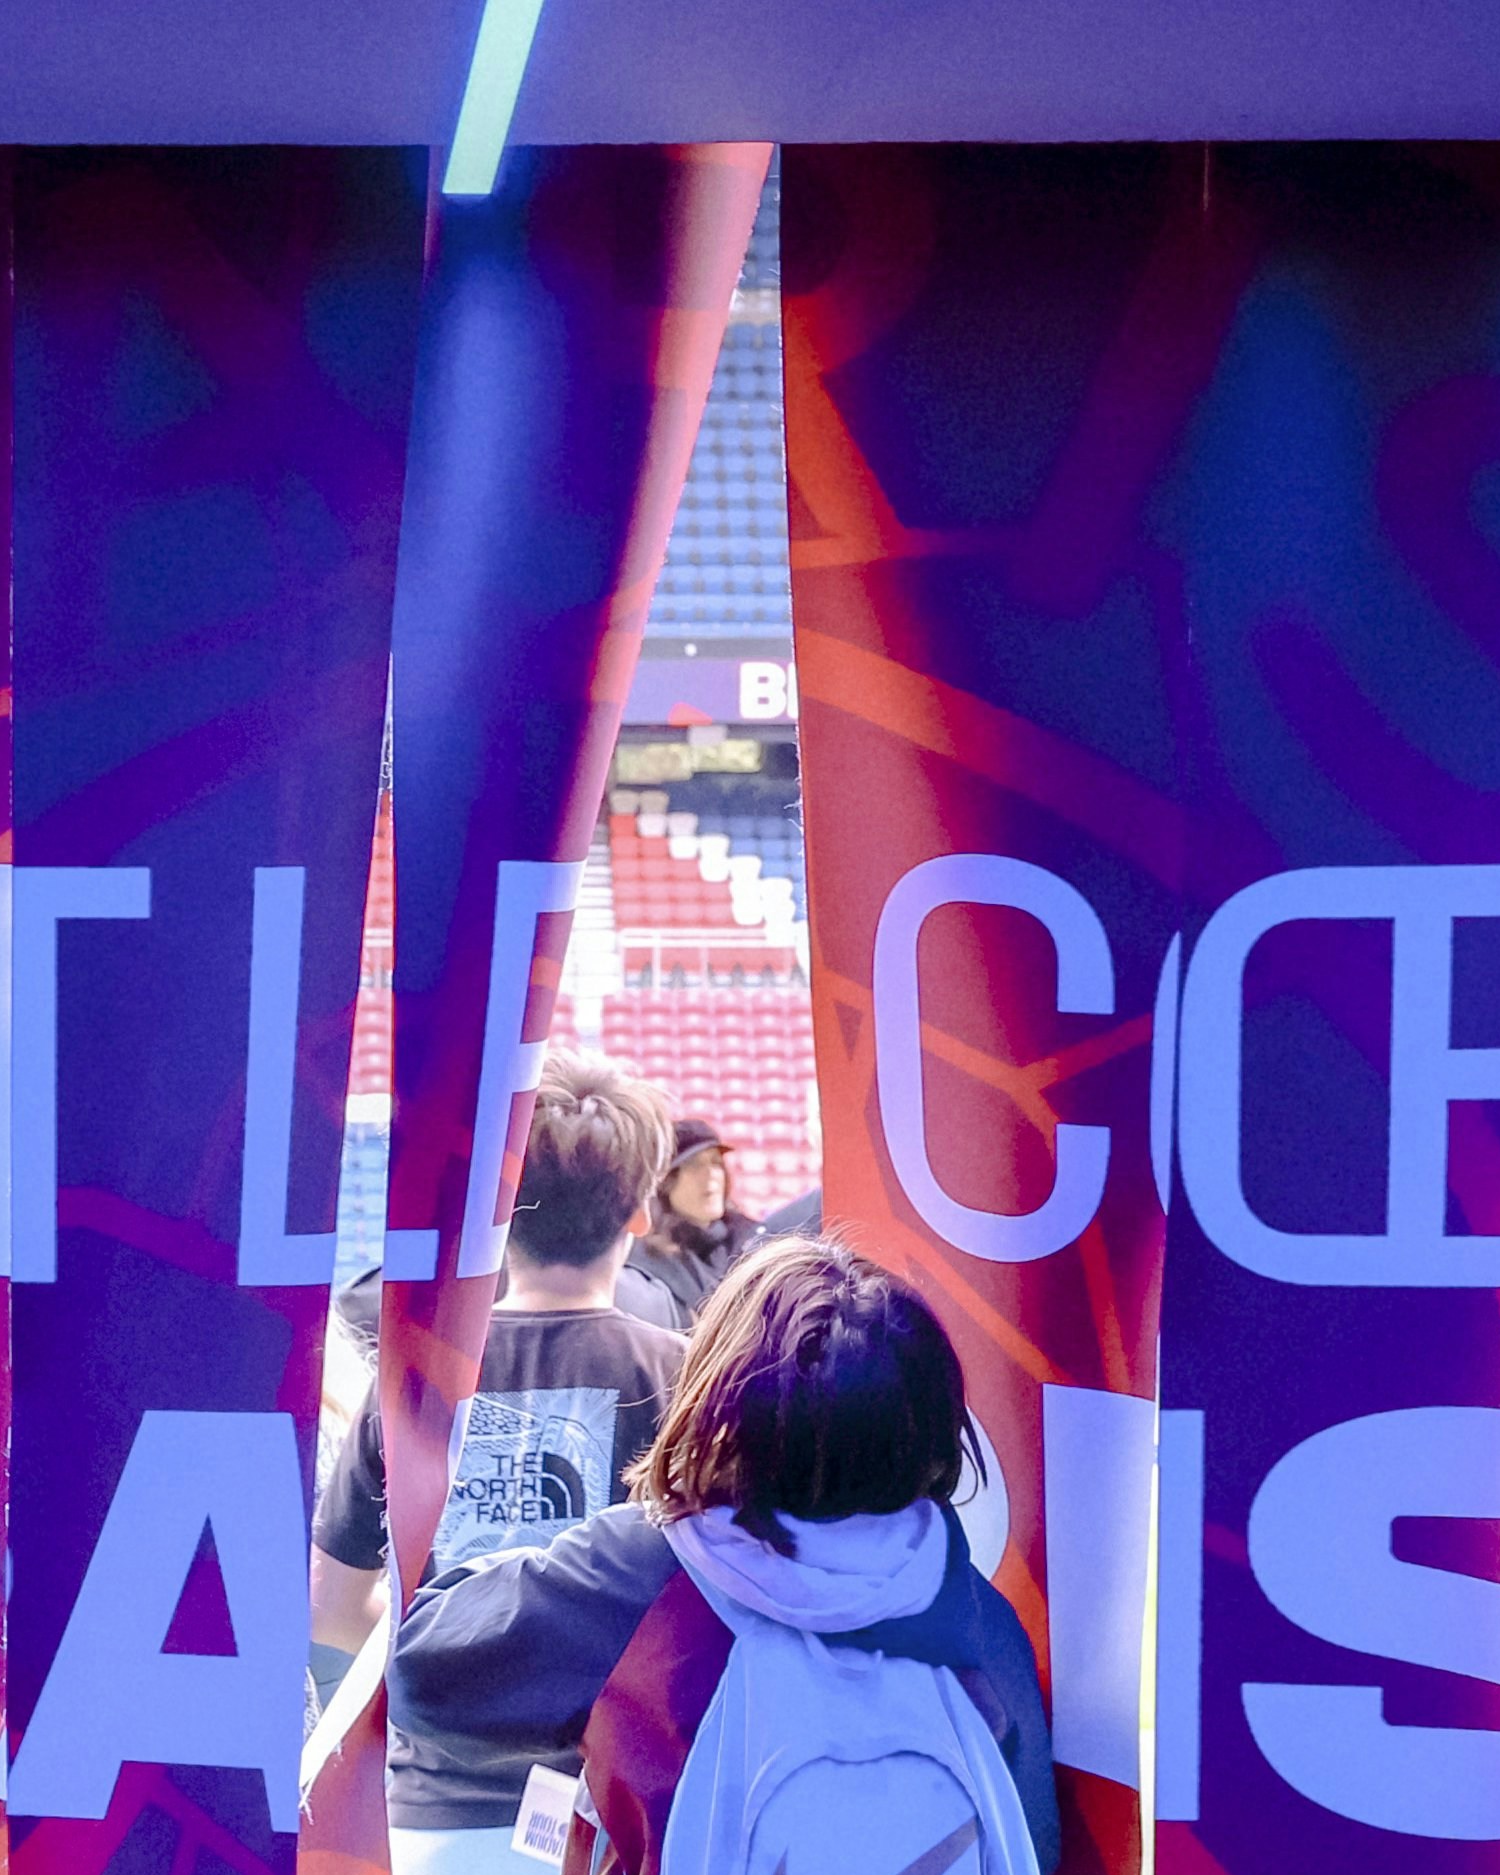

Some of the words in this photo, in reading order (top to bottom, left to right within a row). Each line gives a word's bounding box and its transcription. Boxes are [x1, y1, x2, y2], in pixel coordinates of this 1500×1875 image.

[237, 860, 588, 1286] LE
[490, 1452, 538, 1477] THE
[476, 1500, 538, 1524] FACE
[527, 1809, 558, 1836] TOUR
[524, 1830, 565, 1858] TADIUM
